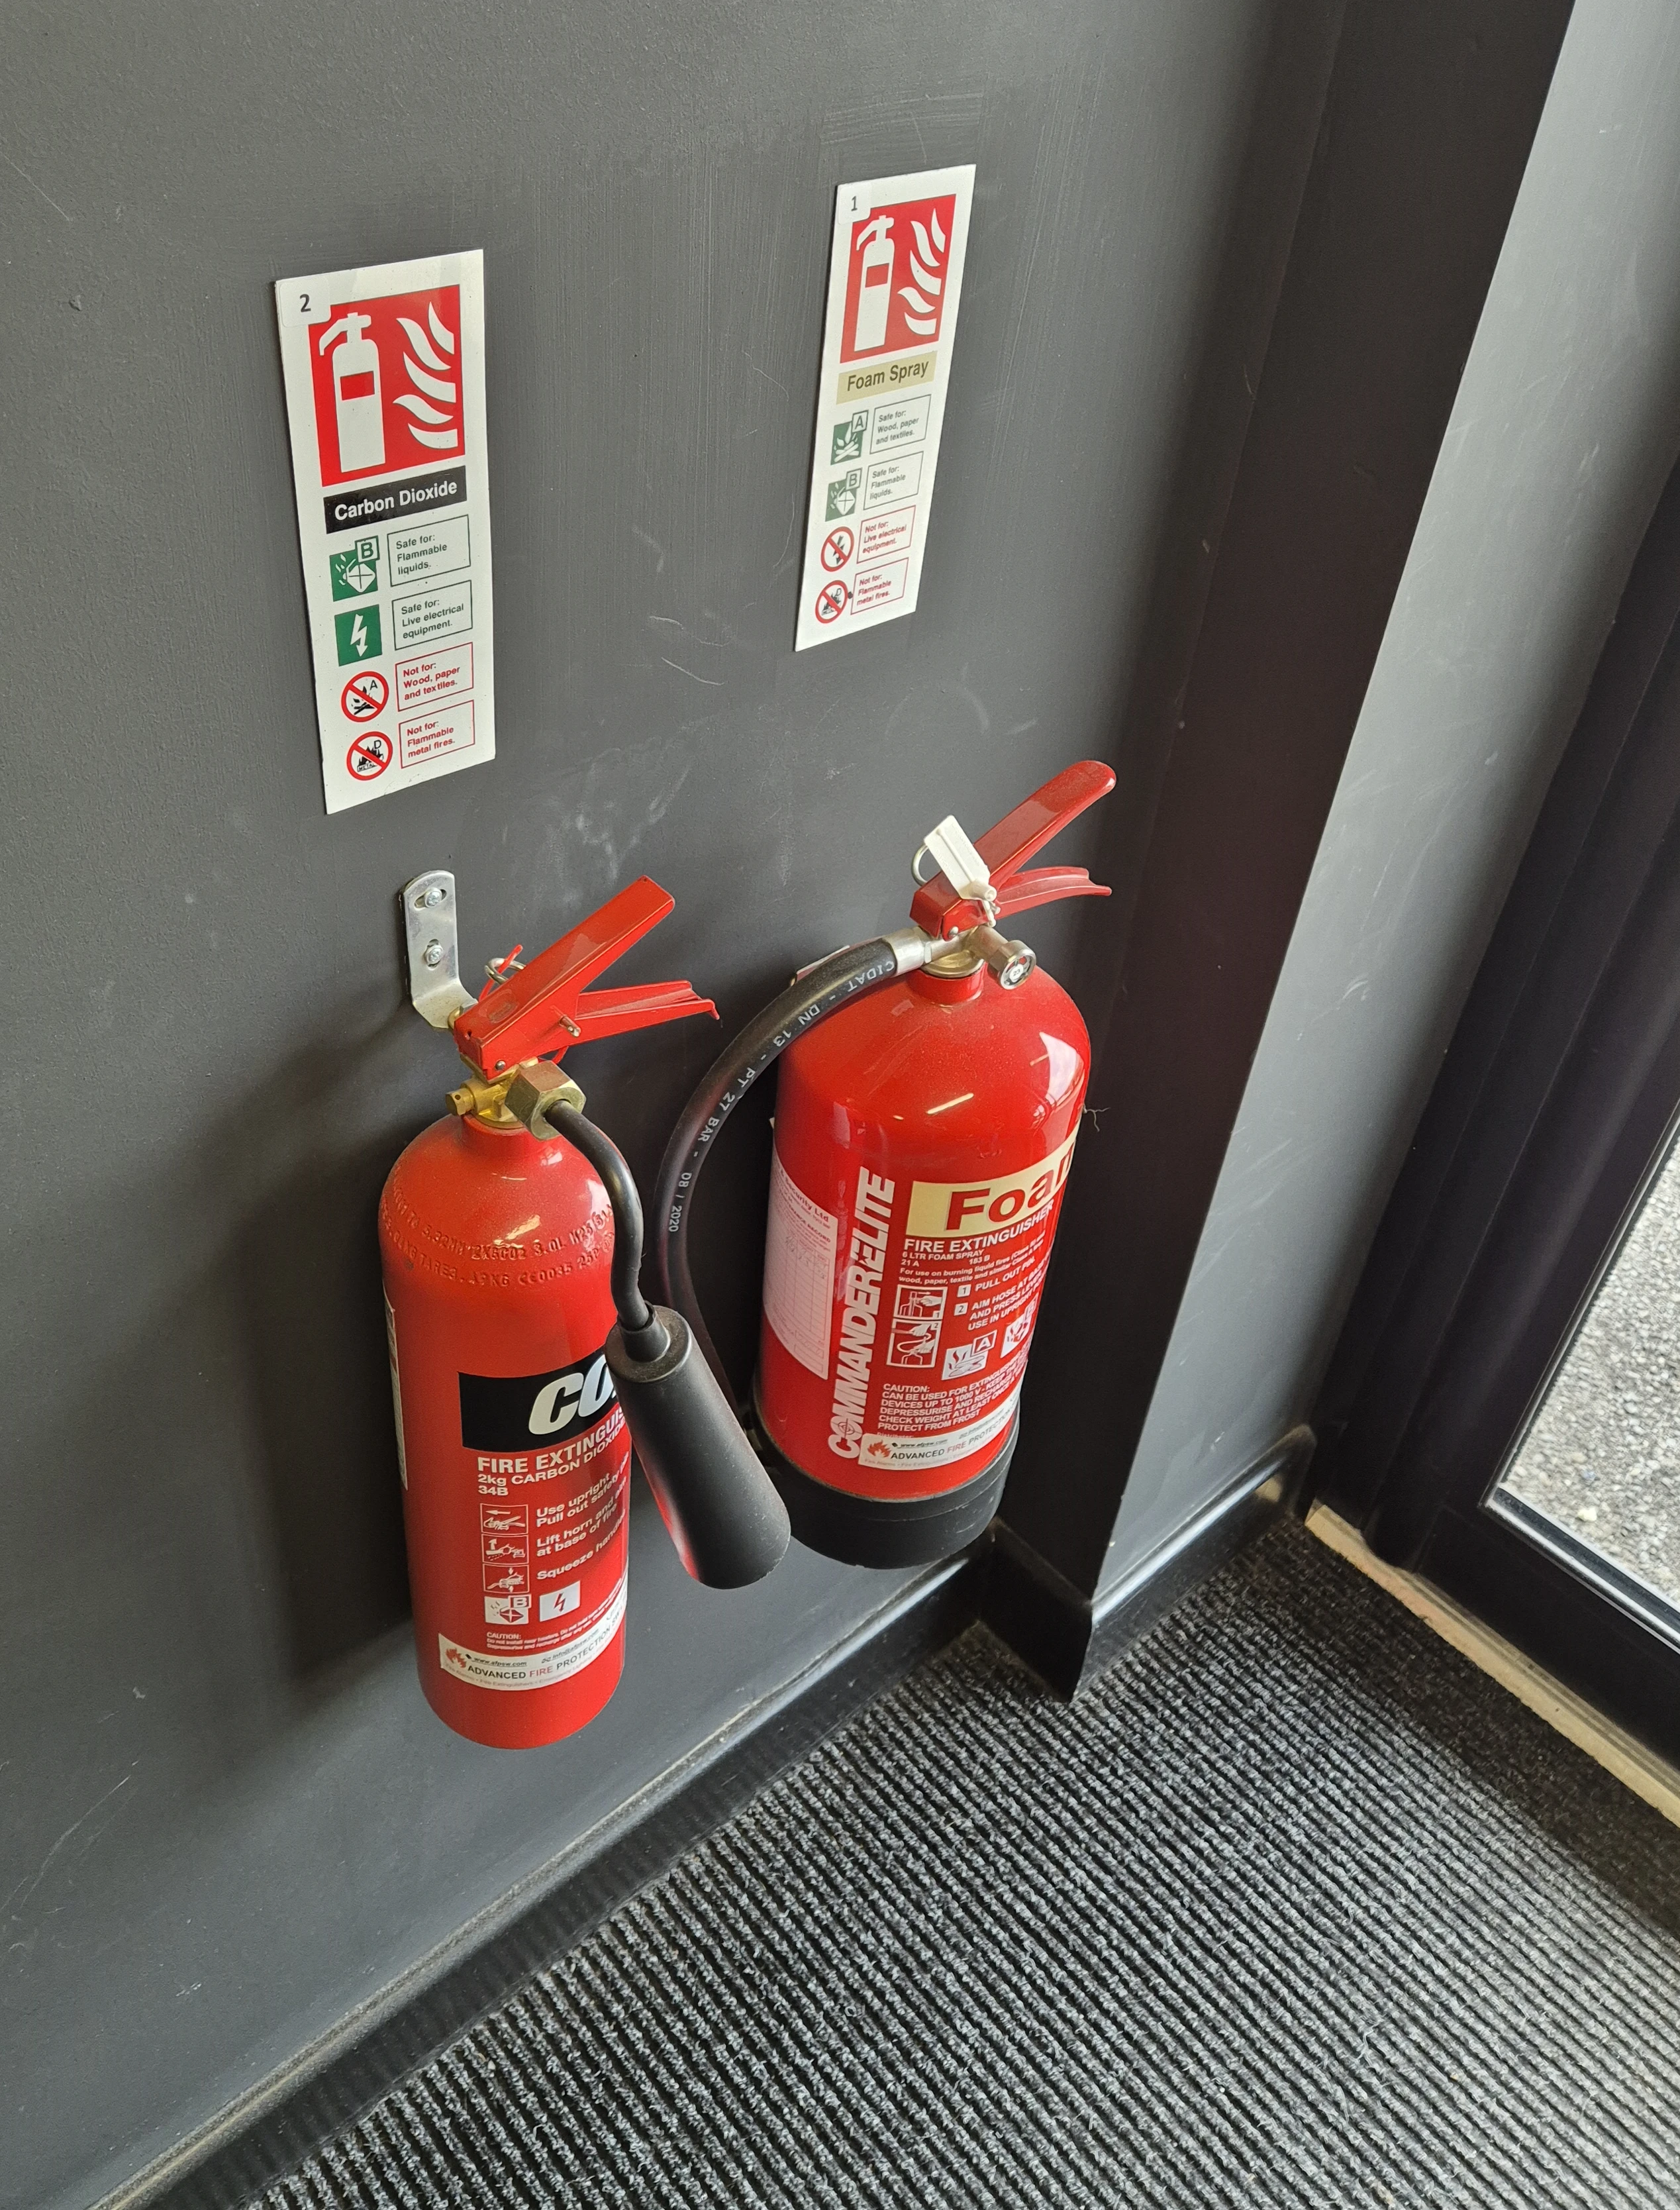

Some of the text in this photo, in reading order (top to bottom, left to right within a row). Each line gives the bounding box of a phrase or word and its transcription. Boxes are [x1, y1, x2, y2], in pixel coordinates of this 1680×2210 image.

[851, 195, 858, 211] 1
[299, 294, 311, 313] 2
[847, 362, 929, 391] Foam Spray
[855, 416, 864, 430] A
[877, 417, 919, 434] Wood, paper
[879, 413, 893, 423] Safe
[876, 429, 914, 445] and textiles.
[848, 474, 858, 487] B
[871, 474, 906, 489] Flammable
[872, 470, 887, 478] Safe
[334, 480, 458, 521] Carbon Dioxide
[869, 488, 893, 500] liquids.
[864, 525, 907, 544] Live electrical
[865, 521, 889, 533] Not for:
[361, 542, 373, 559] B
[396, 534, 435, 550] Safe for:
[862, 538, 897, 554] equipment.
[397, 544, 448, 562] Flammable
[398, 562, 432, 575] liquids.
[858, 581, 891, 596] Flammable
[860, 574, 882, 587] Not for:
[857, 590, 890, 605] metal fires.
[401, 599, 440, 615] Safe for:
[402, 603, 464, 627] Live electrical
[403, 619, 453, 639] equipment.
[403, 662, 436, 678] Not for:
[403, 667, 460, 689] Wood, paper
[370, 679, 378, 690] A
[405, 679, 458, 700] and textiles.
[407, 721, 439, 736] Not for:
[407, 727, 454, 747] Flammable
[373, 740, 382, 750] D
[408, 738, 455, 758] metal fires.
[669, 960, 895, 1232] CIDAT DN 13 PT 27 BAR 08 2020
[815, 1207, 829, 1223] Ltd
[904, 1199, 1054, 1252] FIRE EXTINGUISHER
[956, 1249, 985, 1260] SPRAY
[975, 1261, 995, 1272] liquid
[975, 1278, 1001, 1292] PULL
[1003, 1266, 1021, 1281] OUT
[971, 1298, 990, 1311] AIM
[992, 1285, 1017, 1303] HOSE
[1017, 1277, 1028, 1290] AT
[969, 1291, 1020, 1321] AND PRESS
[968, 1318, 988, 1331] USE
[989, 1313, 999, 1323] IN
[976, 1336, 991, 1351] A
[528, 1354, 617, 1435] CO
[881, 1399, 922, 1408] DEVICES
[940, 1397, 953, 1406] TO
[955, 1391, 973, 1403] 1000
[986, 1372, 1006, 1389] KEEP
[882, 1391, 903, 1401] CAN
[921, 1391, 947, 1400] USED
[949, 1386, 967, 1397] FOR
[883, 1383, 930, 1393] CAUTION:
[879, 1415, 913, 1424] CHECK
[914, 1413, 952, 1424] WEIGHT
[952, 1409, 967, 1419] AT
[966, 1396, 991, 1414] LEAST
[880, 1399, 973, 1416] DEPRESSURISE AND
[877, 1408, 981, 1432] PROTECT FROM FROST
[891, 1449, 945, 1460] ADVANCED
[947, 1441, 967, 1453] FIRE
[477, 1457, 528, 1474] FIRE
[478, 1458, 579, 1486] 2kg CARBON
[478, 1485, 509, 1496] 34B
[536, 1473, 610, 1517] Use upright
[536, 1501, 588, 1528] Pull out
[537, 1496, 613, 1548] Lift horn and
[536, 1503, 617, 1556] at base of fire
[536, 1550, 593, 1580] Squeeze
[514, 1597, 527, 1607] B
[468, 1666, 526, 1680] ADVANCED
[530, 1666, 553, 1678] FIRE
[557, 1625, 611, 1670] PROTECTION
